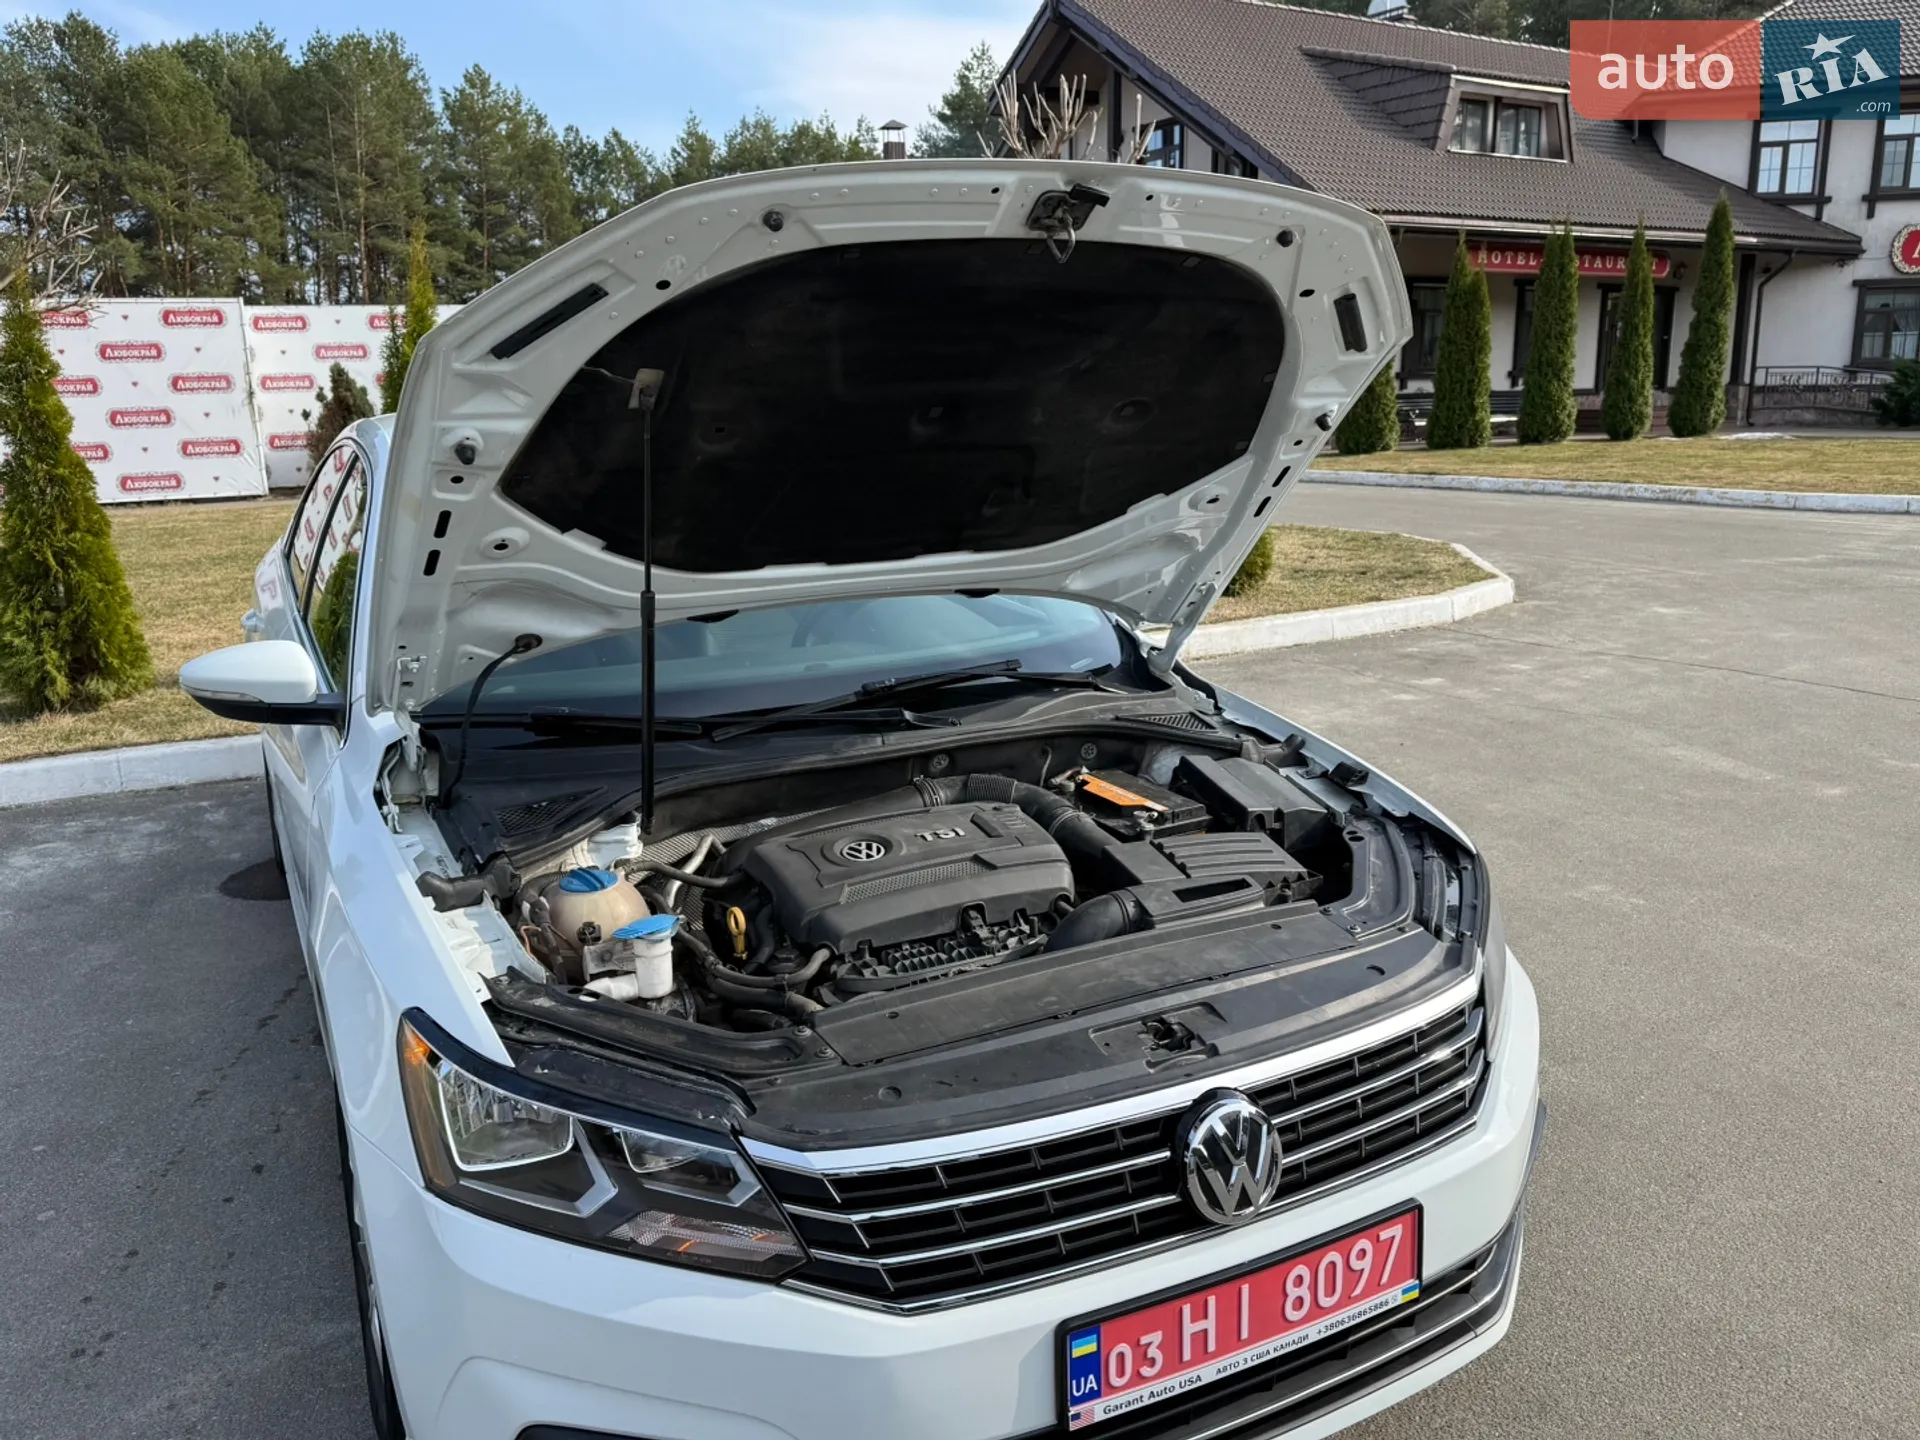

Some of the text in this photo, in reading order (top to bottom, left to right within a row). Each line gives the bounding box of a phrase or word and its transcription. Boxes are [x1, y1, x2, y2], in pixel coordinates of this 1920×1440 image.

[915, 827, 966, 842] TSI
[1107, 1330, 1164, 1388] 03
[1284, 1223, 1404, 1322] 8097
[1215, 1361, 1240, 1375] АВТО
[1250, 1349, 1271, 1362] США
[1273, 1333, 1309, 1353] КАНАДИ
[1072, 1374, 1098, 1397] UA
[1102, 1374, 1203, 1415] Garant Auto USA
